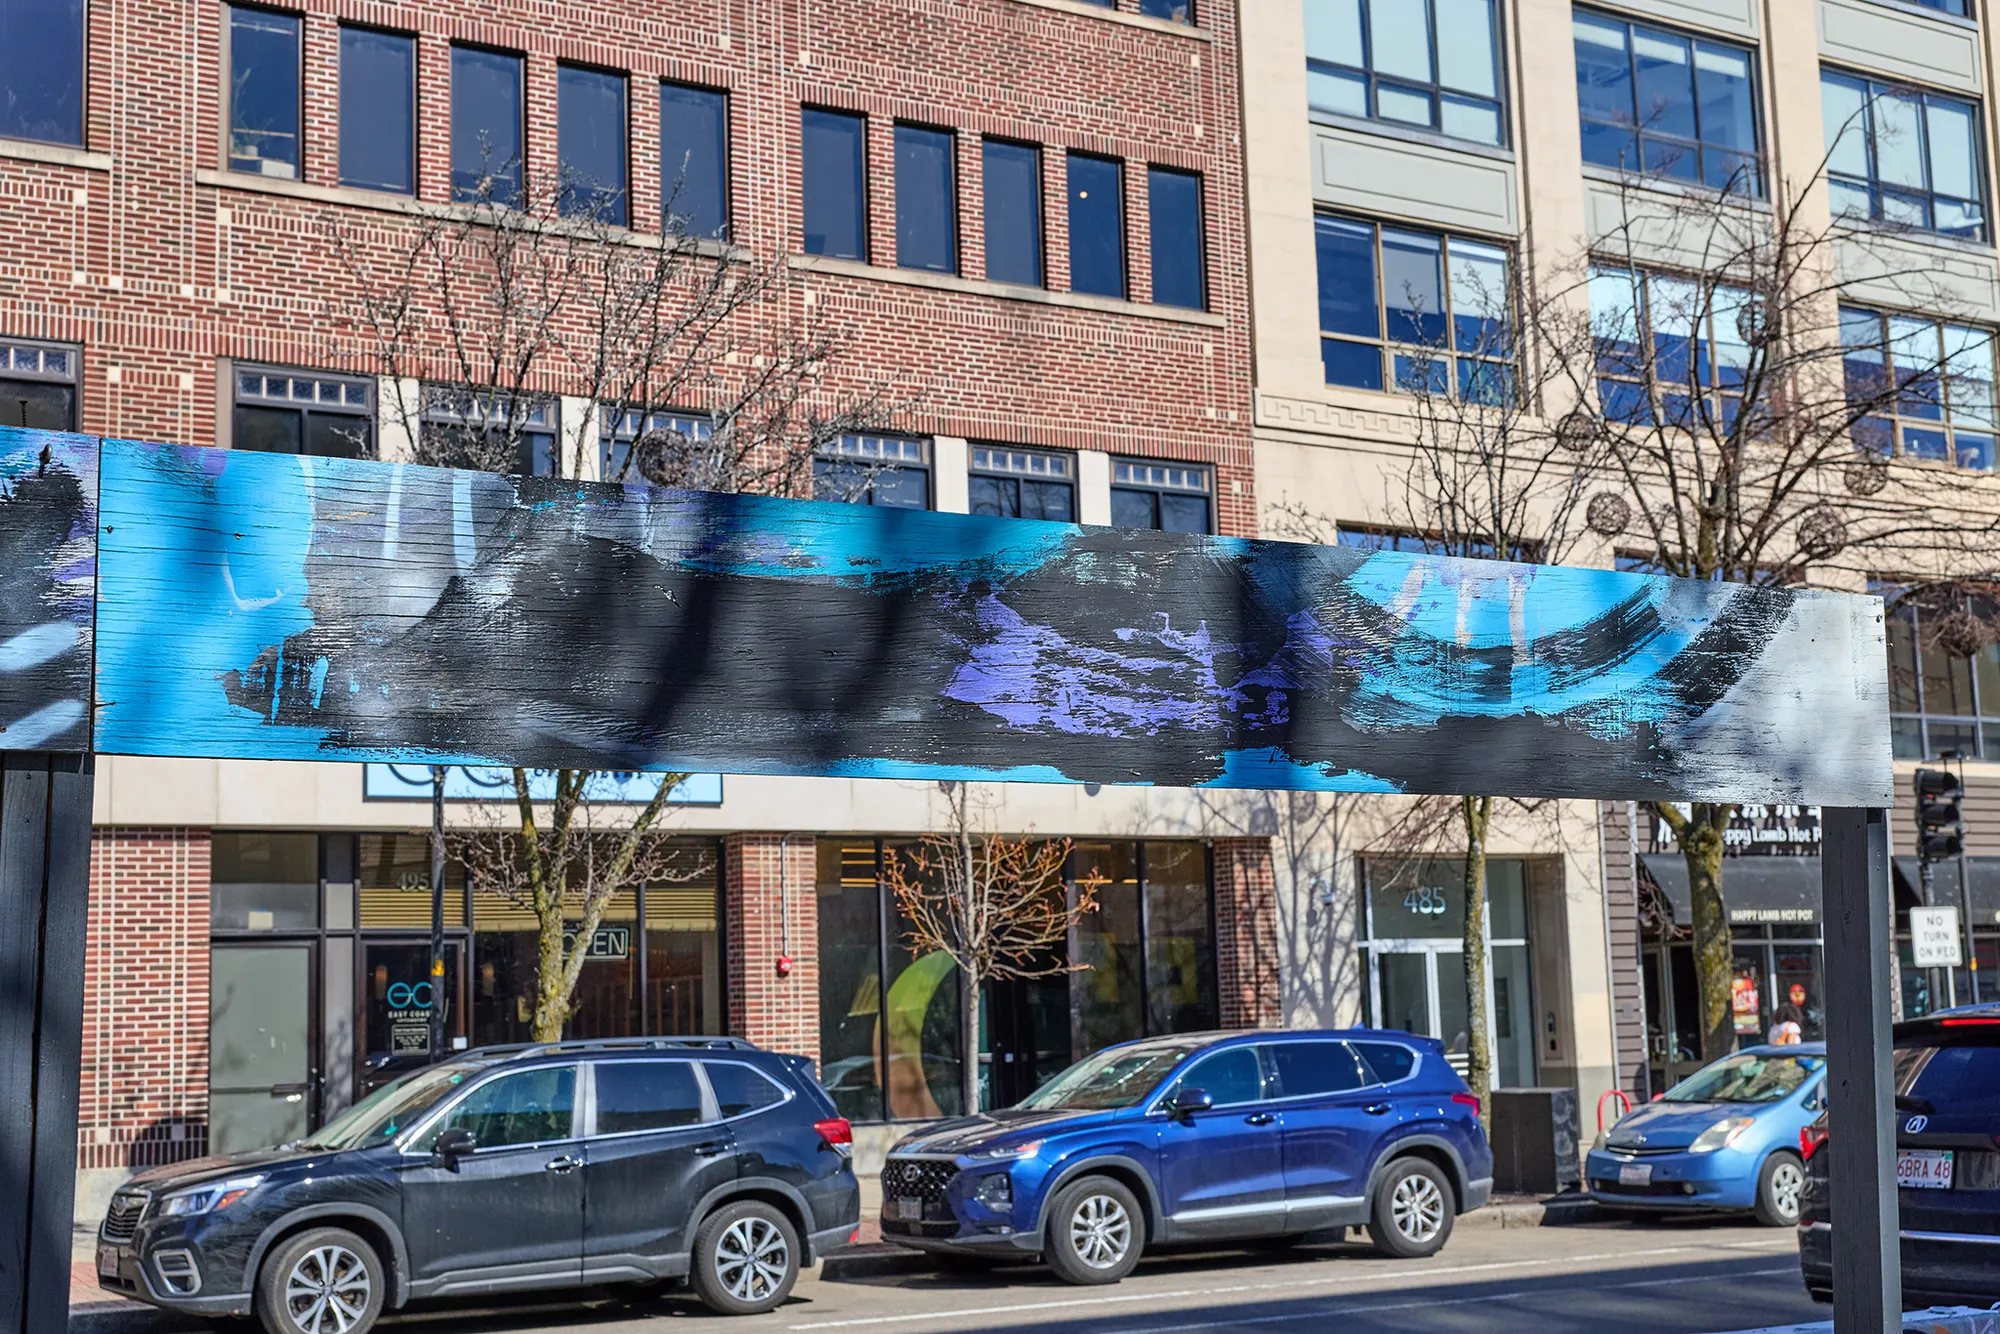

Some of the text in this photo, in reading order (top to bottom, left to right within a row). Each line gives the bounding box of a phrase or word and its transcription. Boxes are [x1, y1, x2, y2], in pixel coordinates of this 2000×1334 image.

[1722, 829, 1752, 846] ppy
[1752, 825, 1788, 843] Lamb
[1788, 826, 1811, 843] Hot
[397, 872, 429, 892] 495
[1403, 886, 1446, 914] 485
[1926, 916, 1943, 926] NO
[562, 932, 625, 955] OEN
[1923, 931, 1949, 942] TURN
[1919, 946, 1956, 958] ON RED
[1897, 1159, 1951, 1179] 6BRA 48
